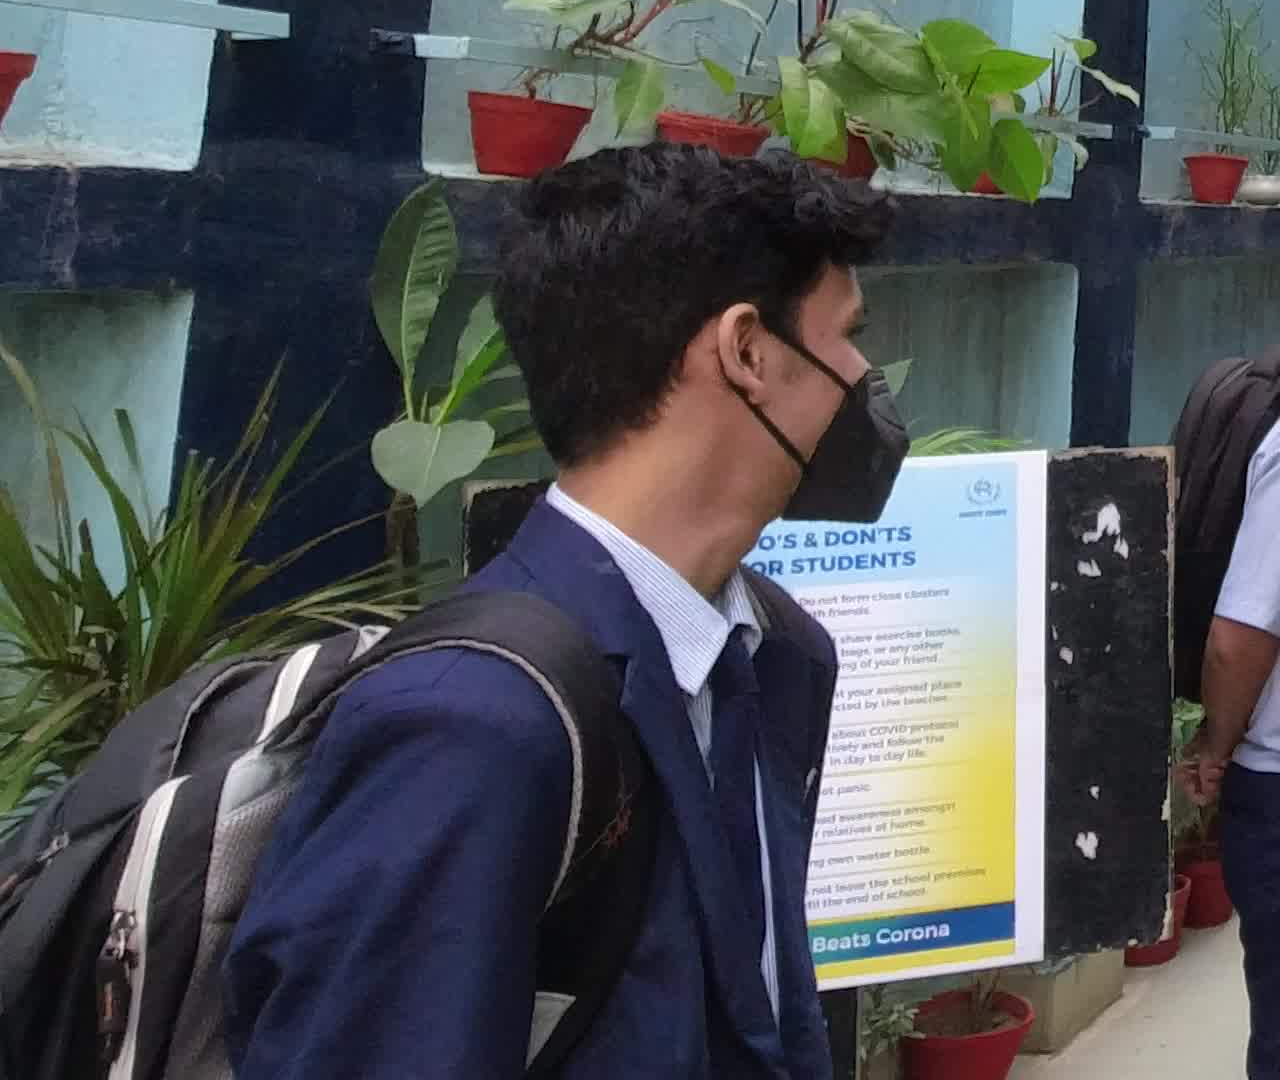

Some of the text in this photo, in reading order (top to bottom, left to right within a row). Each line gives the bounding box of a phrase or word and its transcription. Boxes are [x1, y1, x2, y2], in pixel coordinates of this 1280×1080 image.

[758, 526, 912, 551] O'S & DON'TS
[749, 551, 917, 576] OR STUDENTS
[869, 724, 908, 737] COVID
[812, 923, 951, 954] Beats Corona
